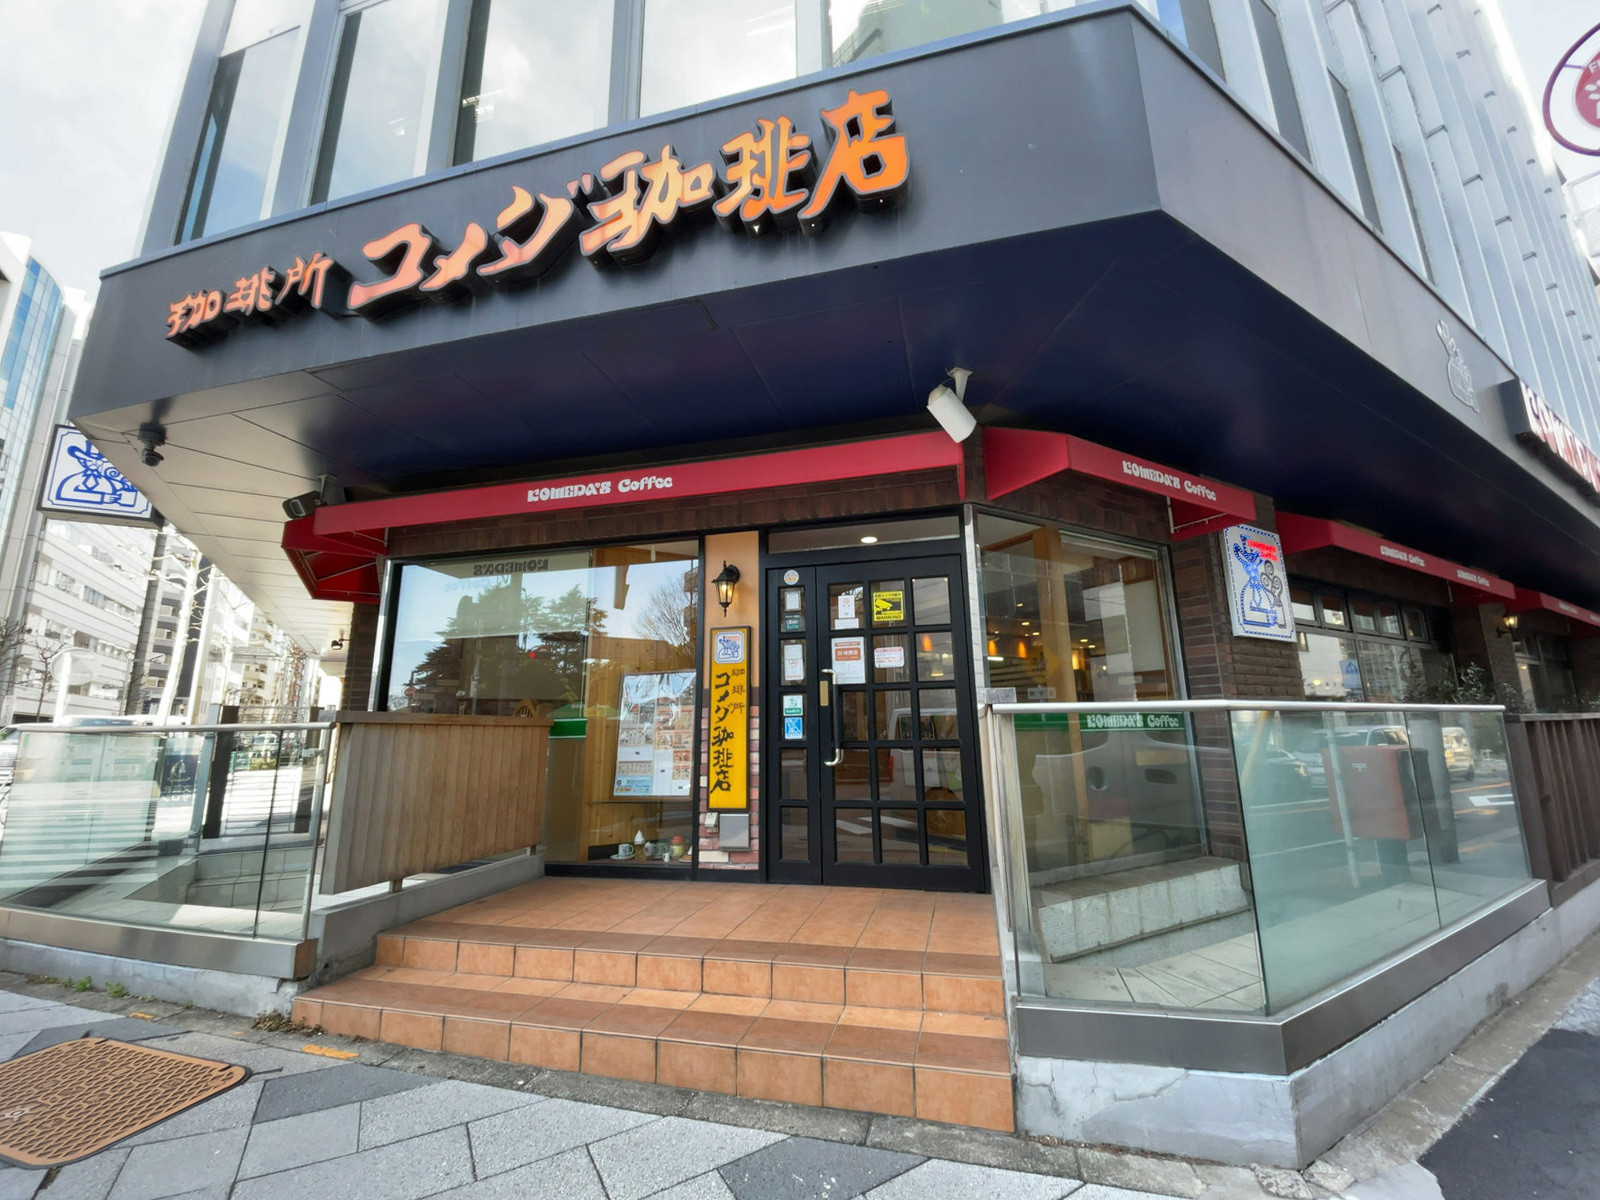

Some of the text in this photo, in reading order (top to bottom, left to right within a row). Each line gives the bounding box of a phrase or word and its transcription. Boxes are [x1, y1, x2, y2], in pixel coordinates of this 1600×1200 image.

[165, 90, 910, 338] 珈琲所 コメダ珈琲店
[527, 476, 673, 503] KOMEDA'S Coffee
[1122, 460, 1217, 501] KOMEDA'S Coffee
[709, 672, 735, 794] コメダ珈琲店
[1087, 713, 1180, 729] KOMEDA'S Coffee
